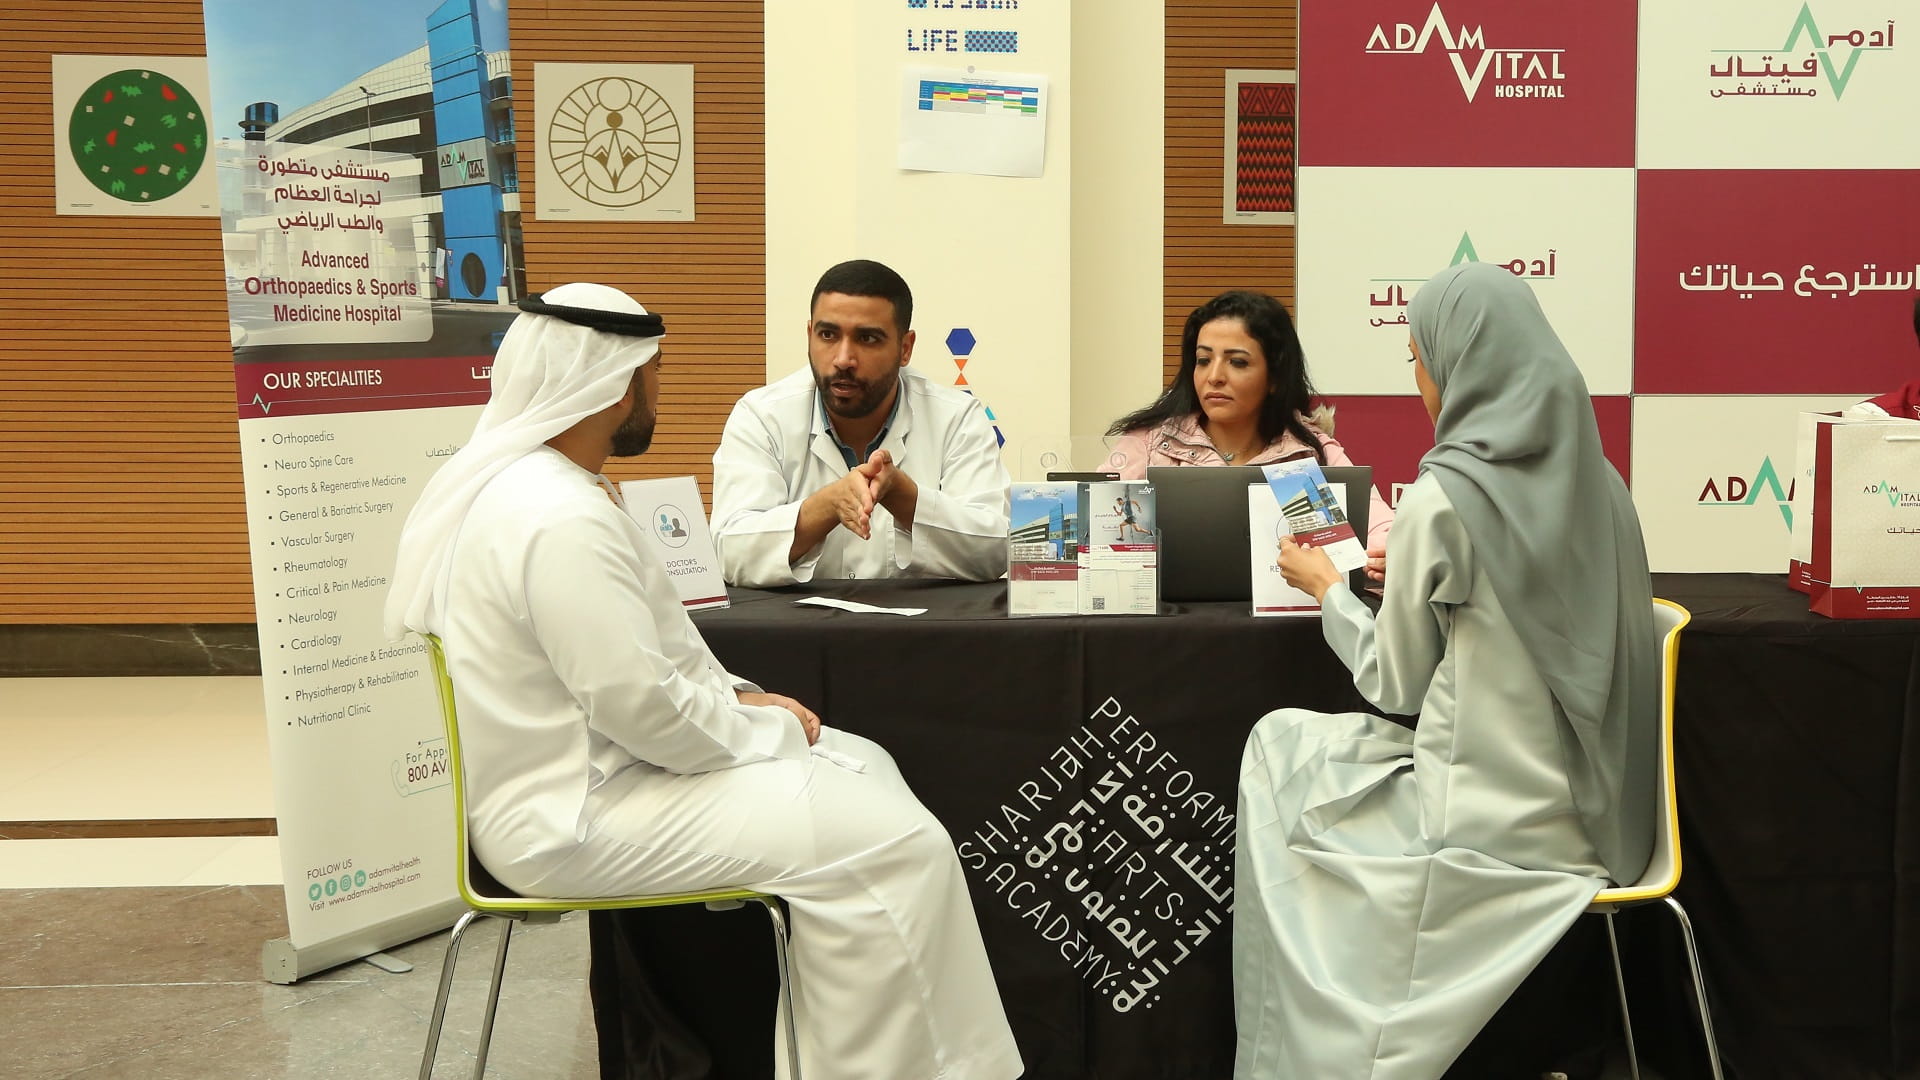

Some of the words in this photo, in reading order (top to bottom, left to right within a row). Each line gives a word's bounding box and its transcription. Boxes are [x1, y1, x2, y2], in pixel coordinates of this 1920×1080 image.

[1365, 1, 1486, 53] ADAM
[908, 29, 957, 51] LIFE
[1448, 49, 1565, 103] VITAL
[1710, 52, 1818, 84] فيتال
[1495, 85, 1565, 98] HOSPITAL
[1710, 82, 1817, 98] مستشفى
[258, 154, 317, 177] متطورة
[322, 159, 390, 183] مستشفى
[274, 185, 331, 203] العظام
[334, 186, 381, 208] لجراحة
[278, 211, 334, 234] الرياضي
[337, 214, 384, 234] والطب
[301, 250, 369, 269] Advanced
[245, 276, 352, 299] Orthopaedics
[357, 279, 366, 295] &
[371, 279, 417, 300] Sports
[1679, 264, 1784, 299] حياتك
[1794, 264, 1920, 299] استرجع
[273, 304, 341, 322] Medicine
[345, 305, 401, 325] Hospital
[263, 373, 301, 389] OUR
[306, 369, 382, 388] SPECIALITIES
[272, 431, 335, 446] Orthopaedics
[275, 457, 307, 471] Neuro
[310, 456, 332, 471] Spine
[335, 454, 353, 466] Care
[277, 483, 308, 498] Sports
[311, 483, 318, 494] &
[320, 478, 370, 493] Regenerative
[371, 475, 407, 488] Medicine
[1864, 480, 1898, 494] ADAM
[279, 508, 319, 522] General
[322, 507, 328, 518] &
[331, 503, 363, 517] Bariatric
[364, 501, 394, 515] Surgery
[281, 533, 322, 547] Vascular
[325, 530, 355, 545] Surgery
[284, 556, 348, 573] Rheumatology
[667, 559, 697, 568] DOCTORS
[667, 566, 708, 577] NSULTATION
[286, 584, 321, 599] Critical
[323, 583, 330, 594] &
[333, 581, 349, 592] Pain
[351, 576, 387, 589] Medicine
[289, 608, 337, 625] Neurology
[291, 633, 342, 650] Cardiology
[293, 659, 329, 676] Internal
[332, 654, 368, 668] Medicine
[370, 651, 376, 661] &
[379, 642, 427, 660] Endocrinolog
[295, 681, 356, 702] Physiotherapy
[358, 678, 365, 689] &
[367, 668, 419, 687] Rehabilitation
[298, 708, 346, 728] Nutritional
[347, 703, 371, 717] Clinic
[406, 753, 422, 764] For
[408, 764, 428, 782] 800
[431, 759, 447, 777] AV
[1090, 696, 1237, 855] PERFORMI
[958, 725, 1104, 870] SHARJAH
[307, 862, 340, 880] FOLLOW
[342, 859, 353, 870] US
[369, 856, 421, 880] adamvitalhealth
[1093, 830, 1184, 921] ARTS
[309, 901, 325, 912] Visit
[329, 872, 421, 907] www.adamvitalhospital.com
[985, 862, 1122, 990] ACADEMY
